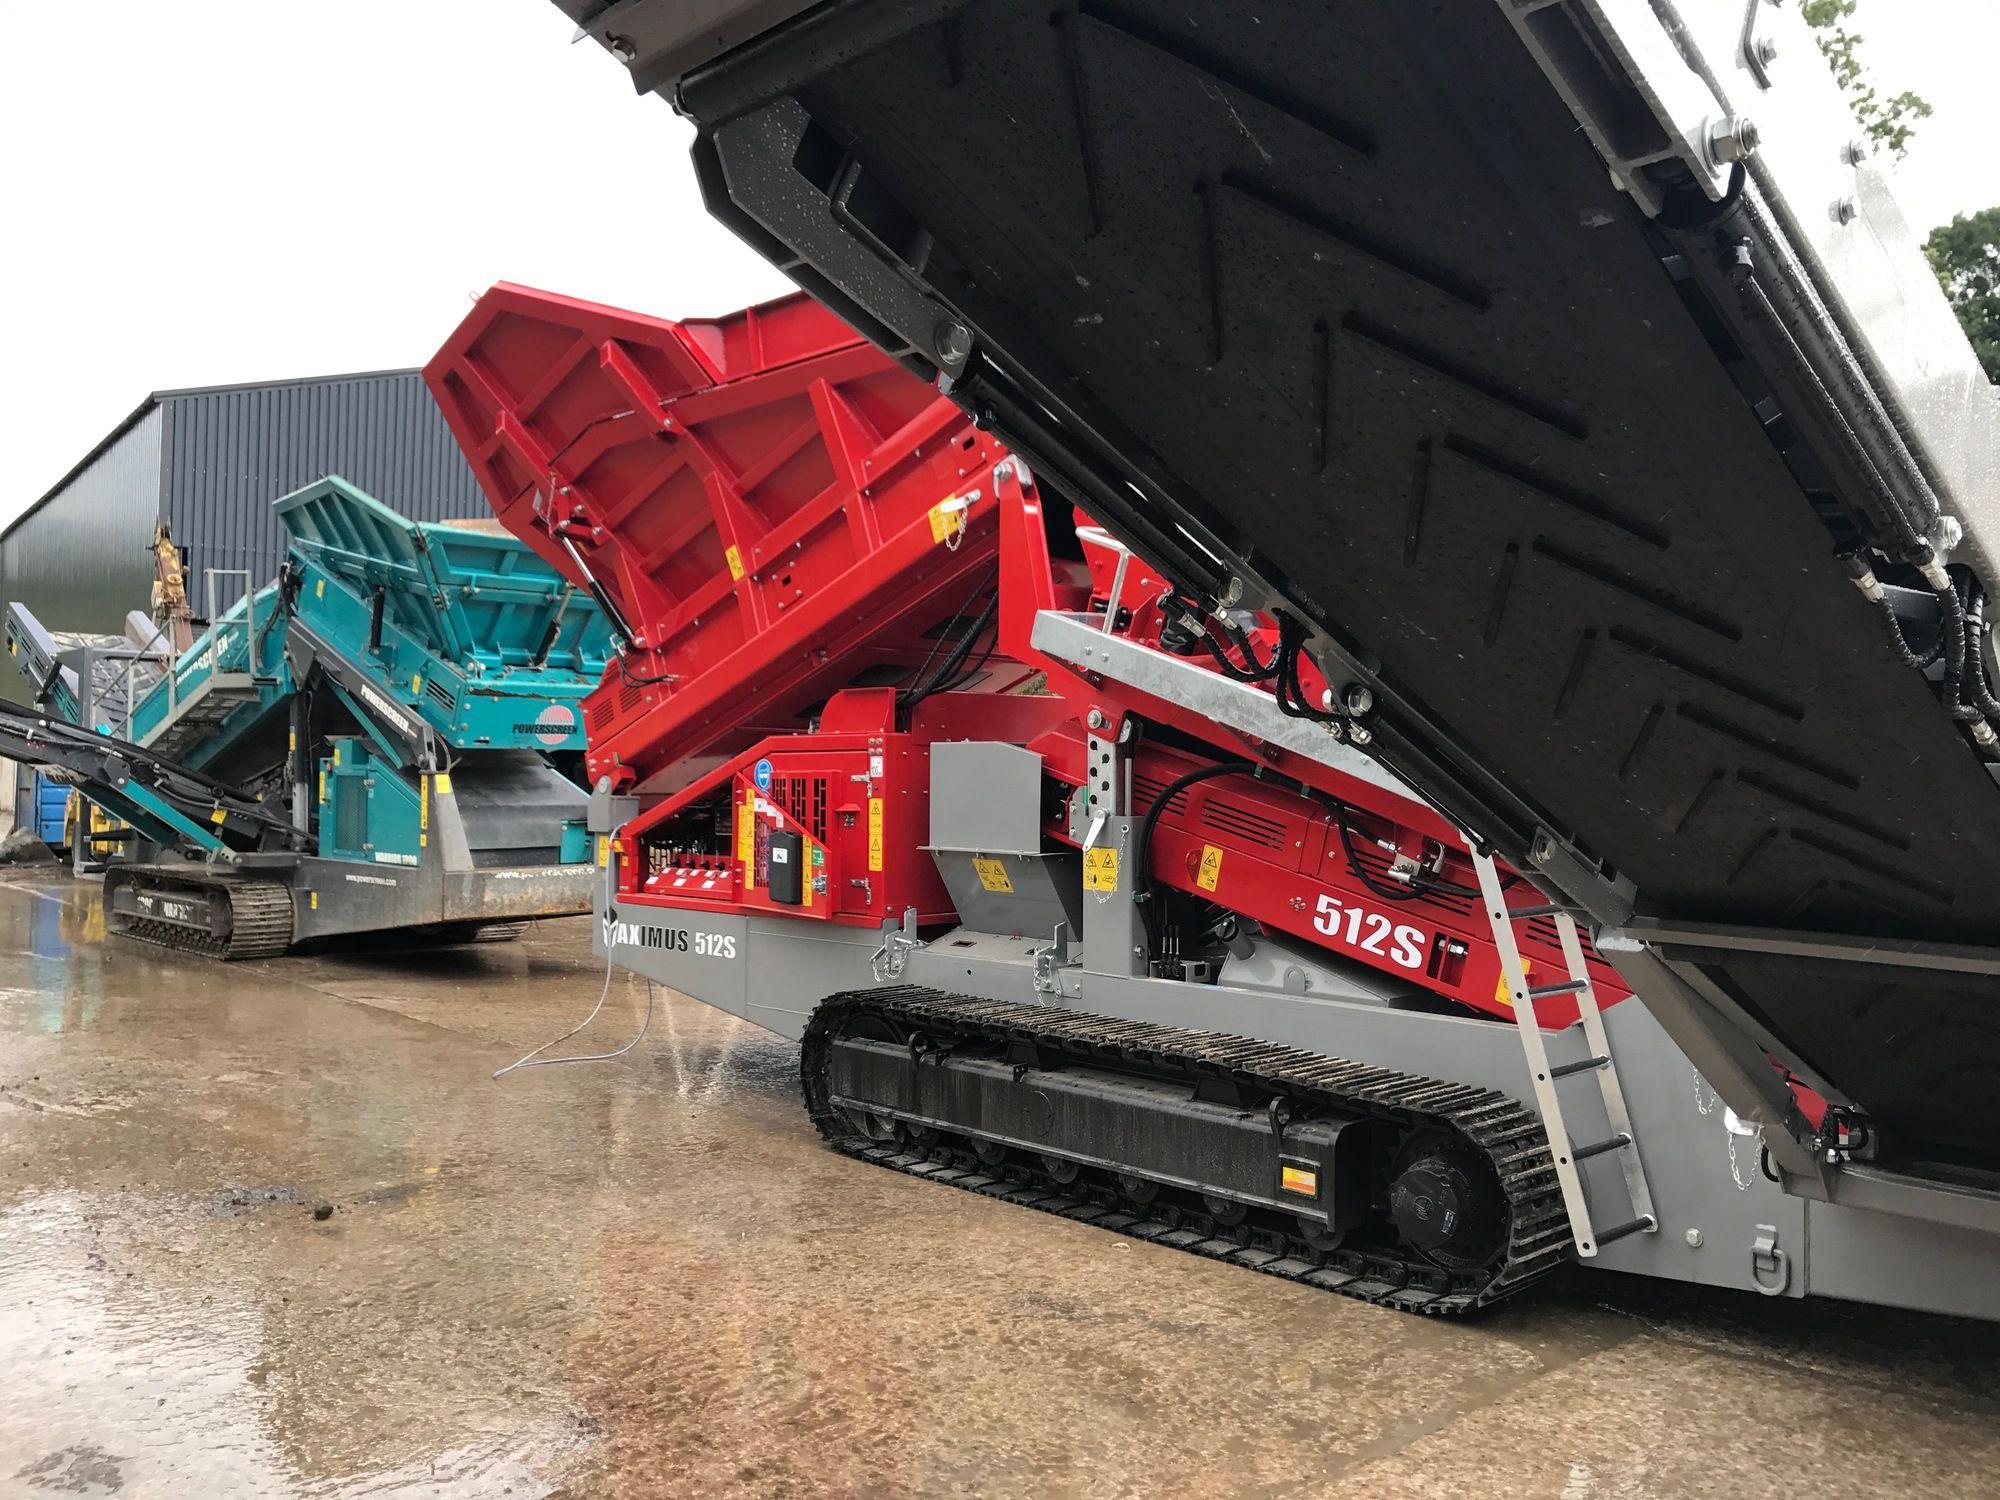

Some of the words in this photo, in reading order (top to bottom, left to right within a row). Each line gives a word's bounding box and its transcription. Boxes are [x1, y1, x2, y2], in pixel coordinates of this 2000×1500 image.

[361, 684, 409, 733] POWERSCREEN
[512, 723, 578, 735] POWERSCREEN
[345, 874, 397, 887] www.powerscreen.com
[602, 917, 689, 952] MAXIMUS
[694, 931, 737, 959] 512S
[1313, 893, 1426, 969] 512S
